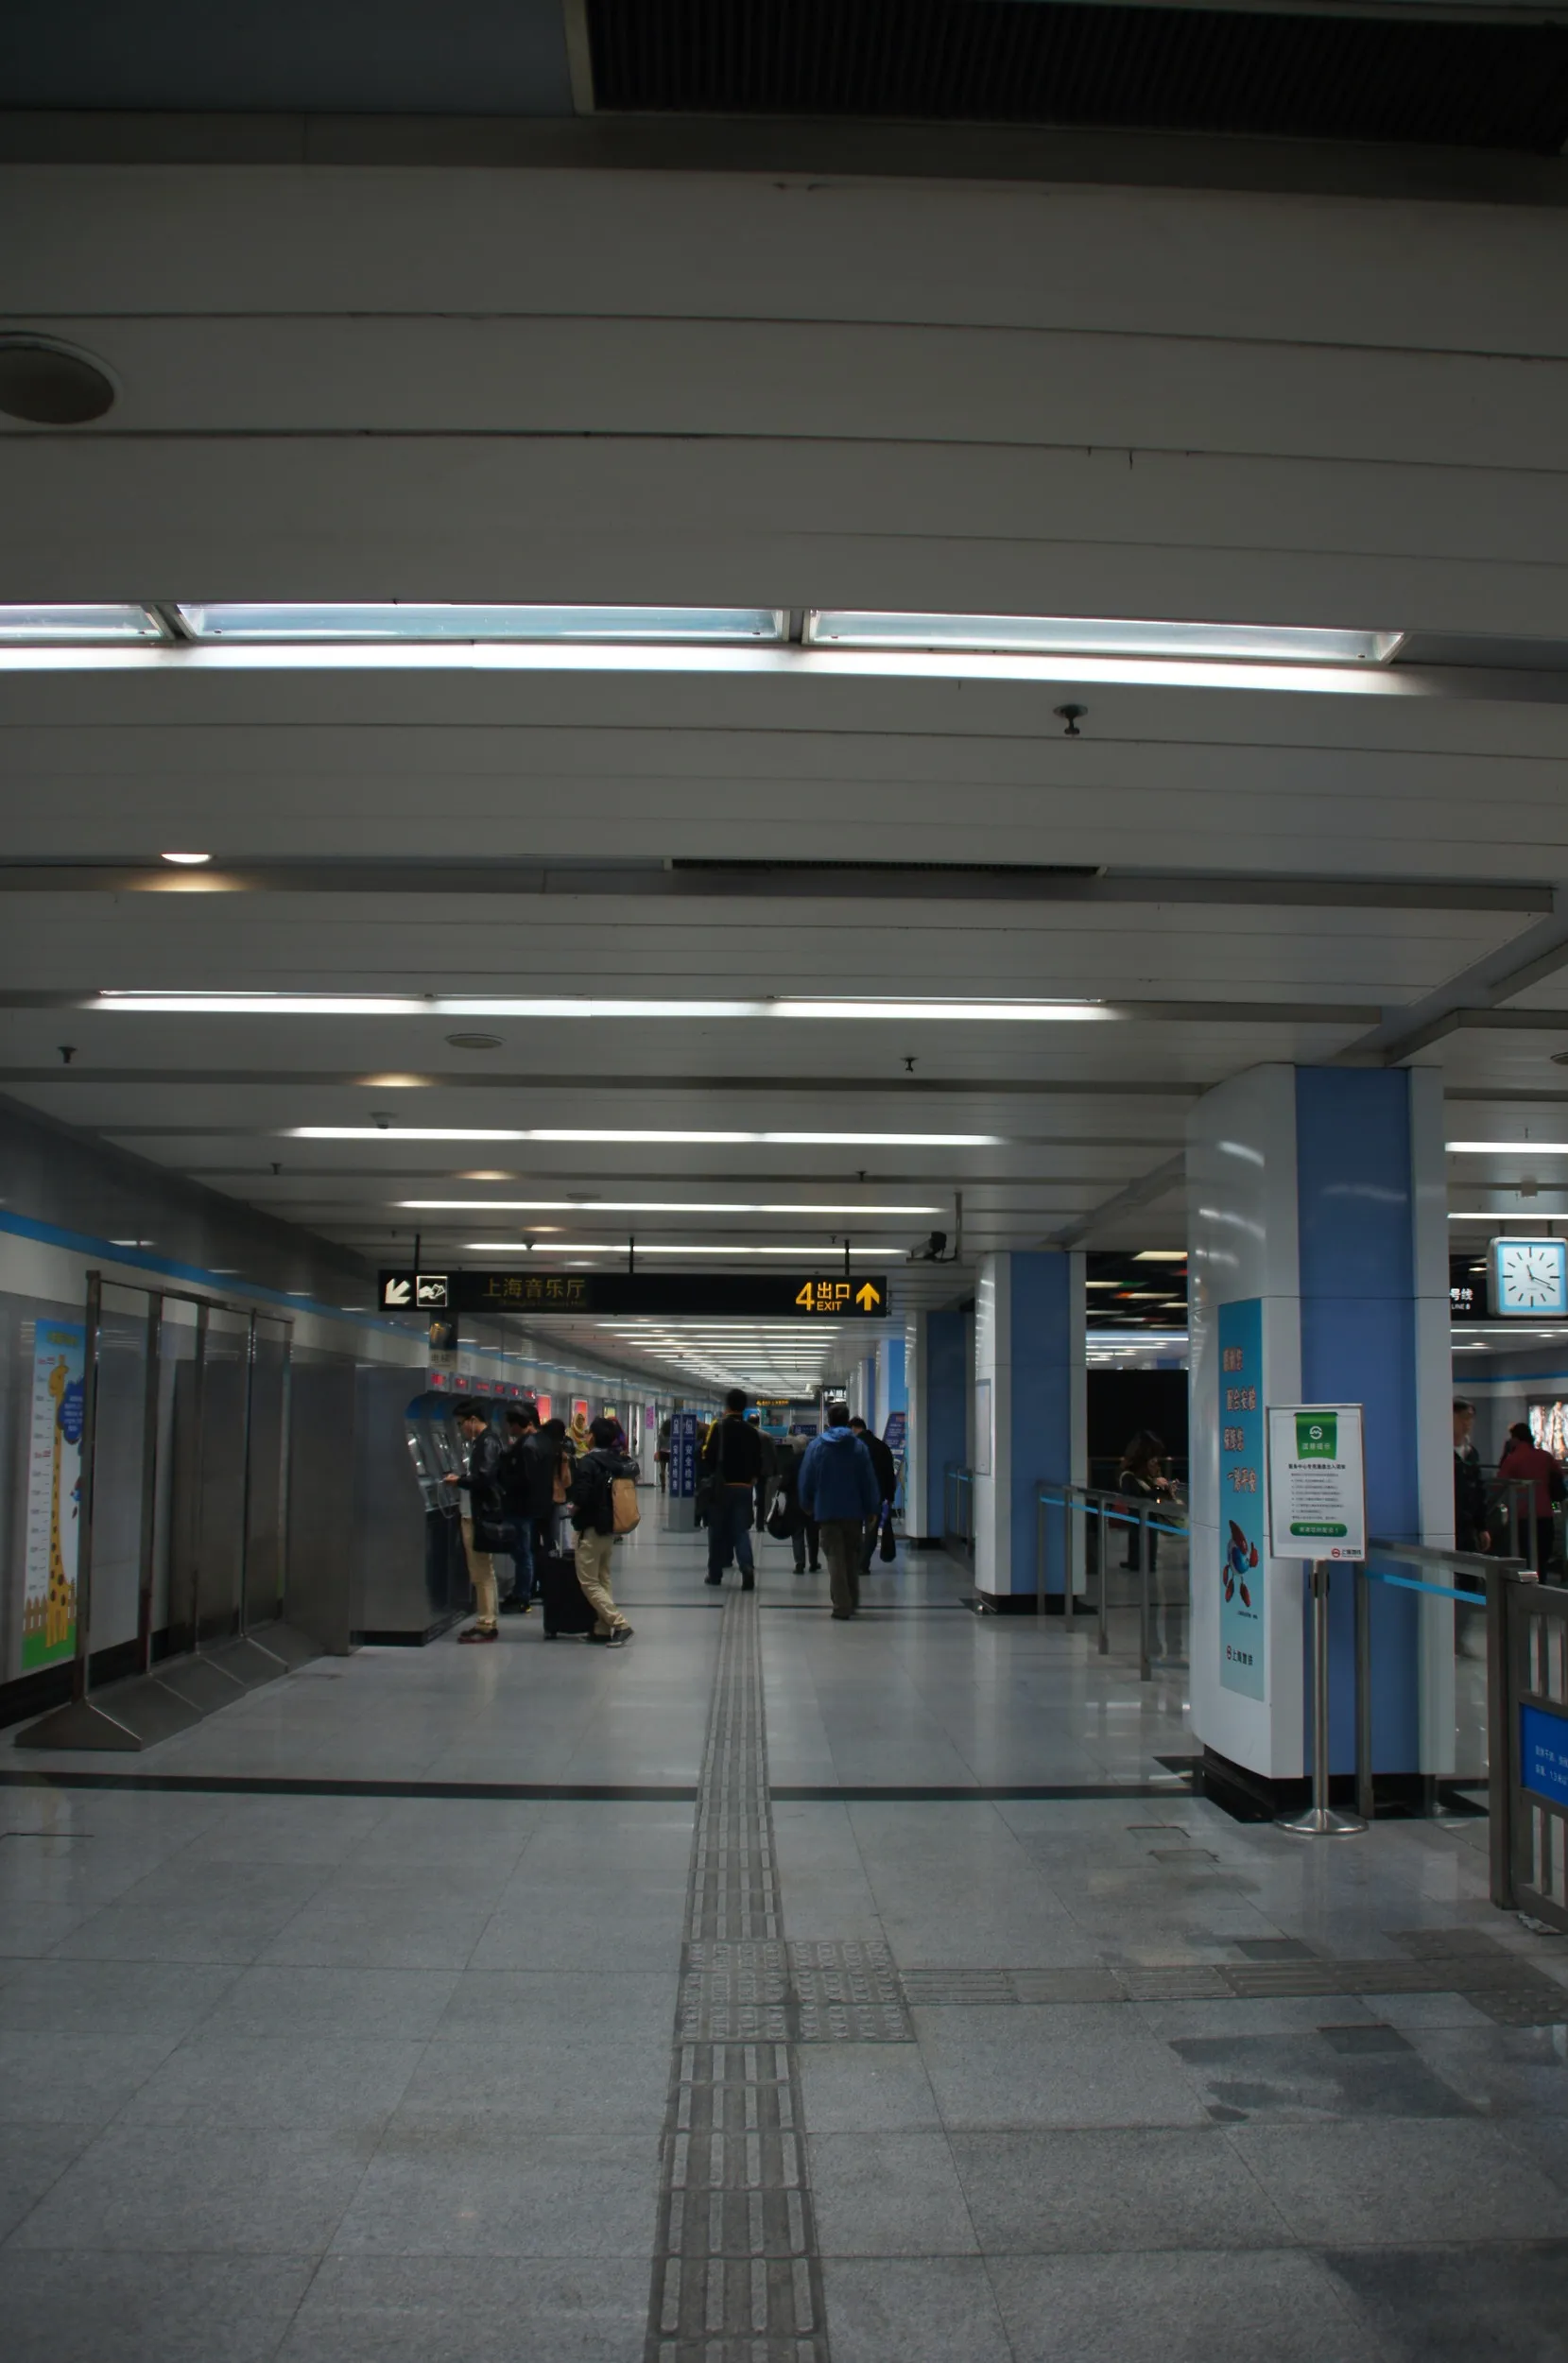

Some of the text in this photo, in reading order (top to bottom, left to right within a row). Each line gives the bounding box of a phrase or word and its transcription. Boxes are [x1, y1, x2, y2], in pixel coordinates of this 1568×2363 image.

[482, 1276, 586, 1299] 上海音乐厅
[795, 1281, 851, 1312] 4 出口
[1449, 1287, 1473, 1302] 号线
[817, 1301, 842, 1312] EXIT
